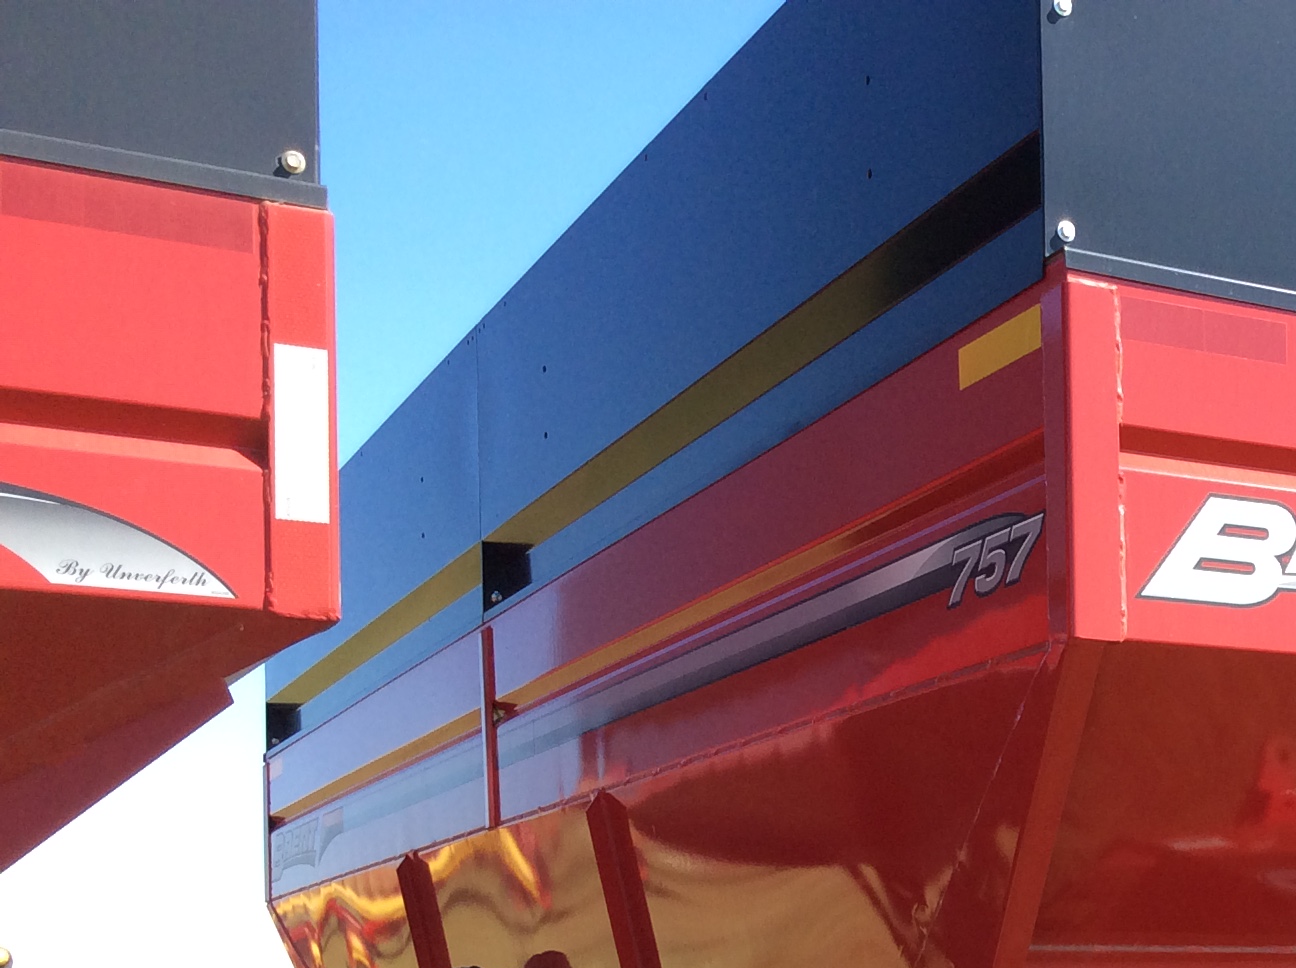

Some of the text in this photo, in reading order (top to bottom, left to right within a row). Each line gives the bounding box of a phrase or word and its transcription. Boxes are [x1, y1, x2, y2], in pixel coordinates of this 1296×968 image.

[56, 558, 207, 590] By Unverferth
[946, 509, 1045, 610] 757
